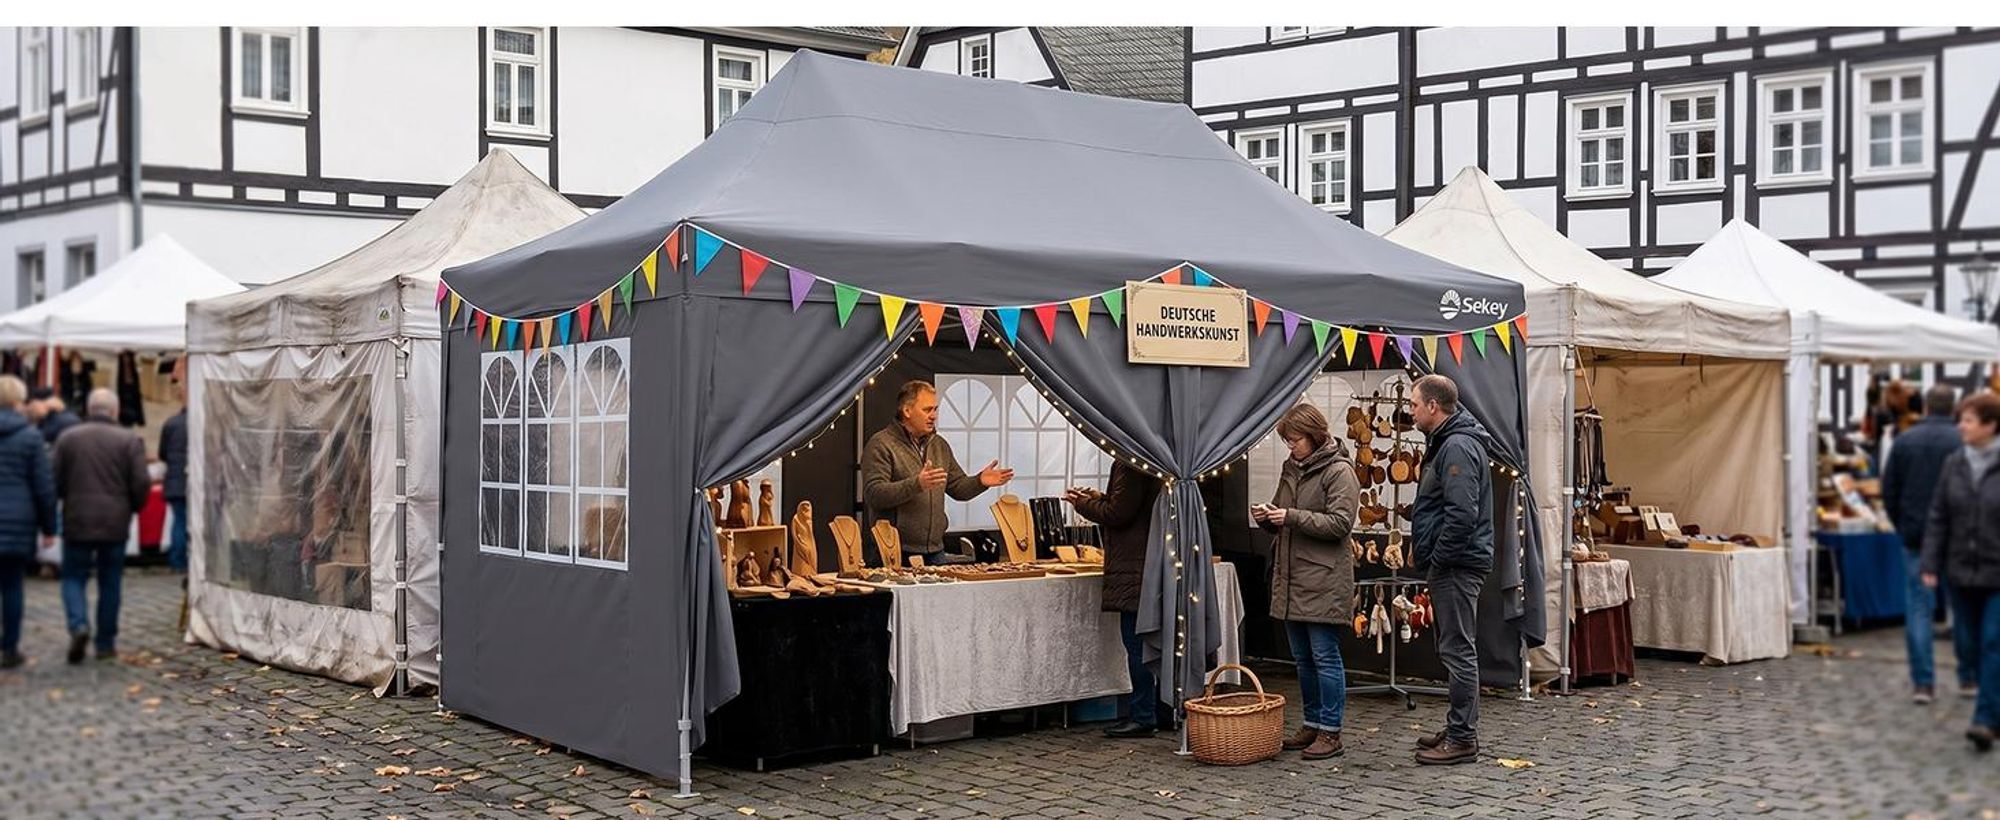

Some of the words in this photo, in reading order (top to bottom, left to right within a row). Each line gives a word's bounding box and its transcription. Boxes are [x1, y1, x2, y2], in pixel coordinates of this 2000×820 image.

[1161, 306, 1216, 322] DEUTSCHE
[1461, 297, 1508, 319] Sekey
[1136, 323, 1240, 341] HANDWERKSKUNST
